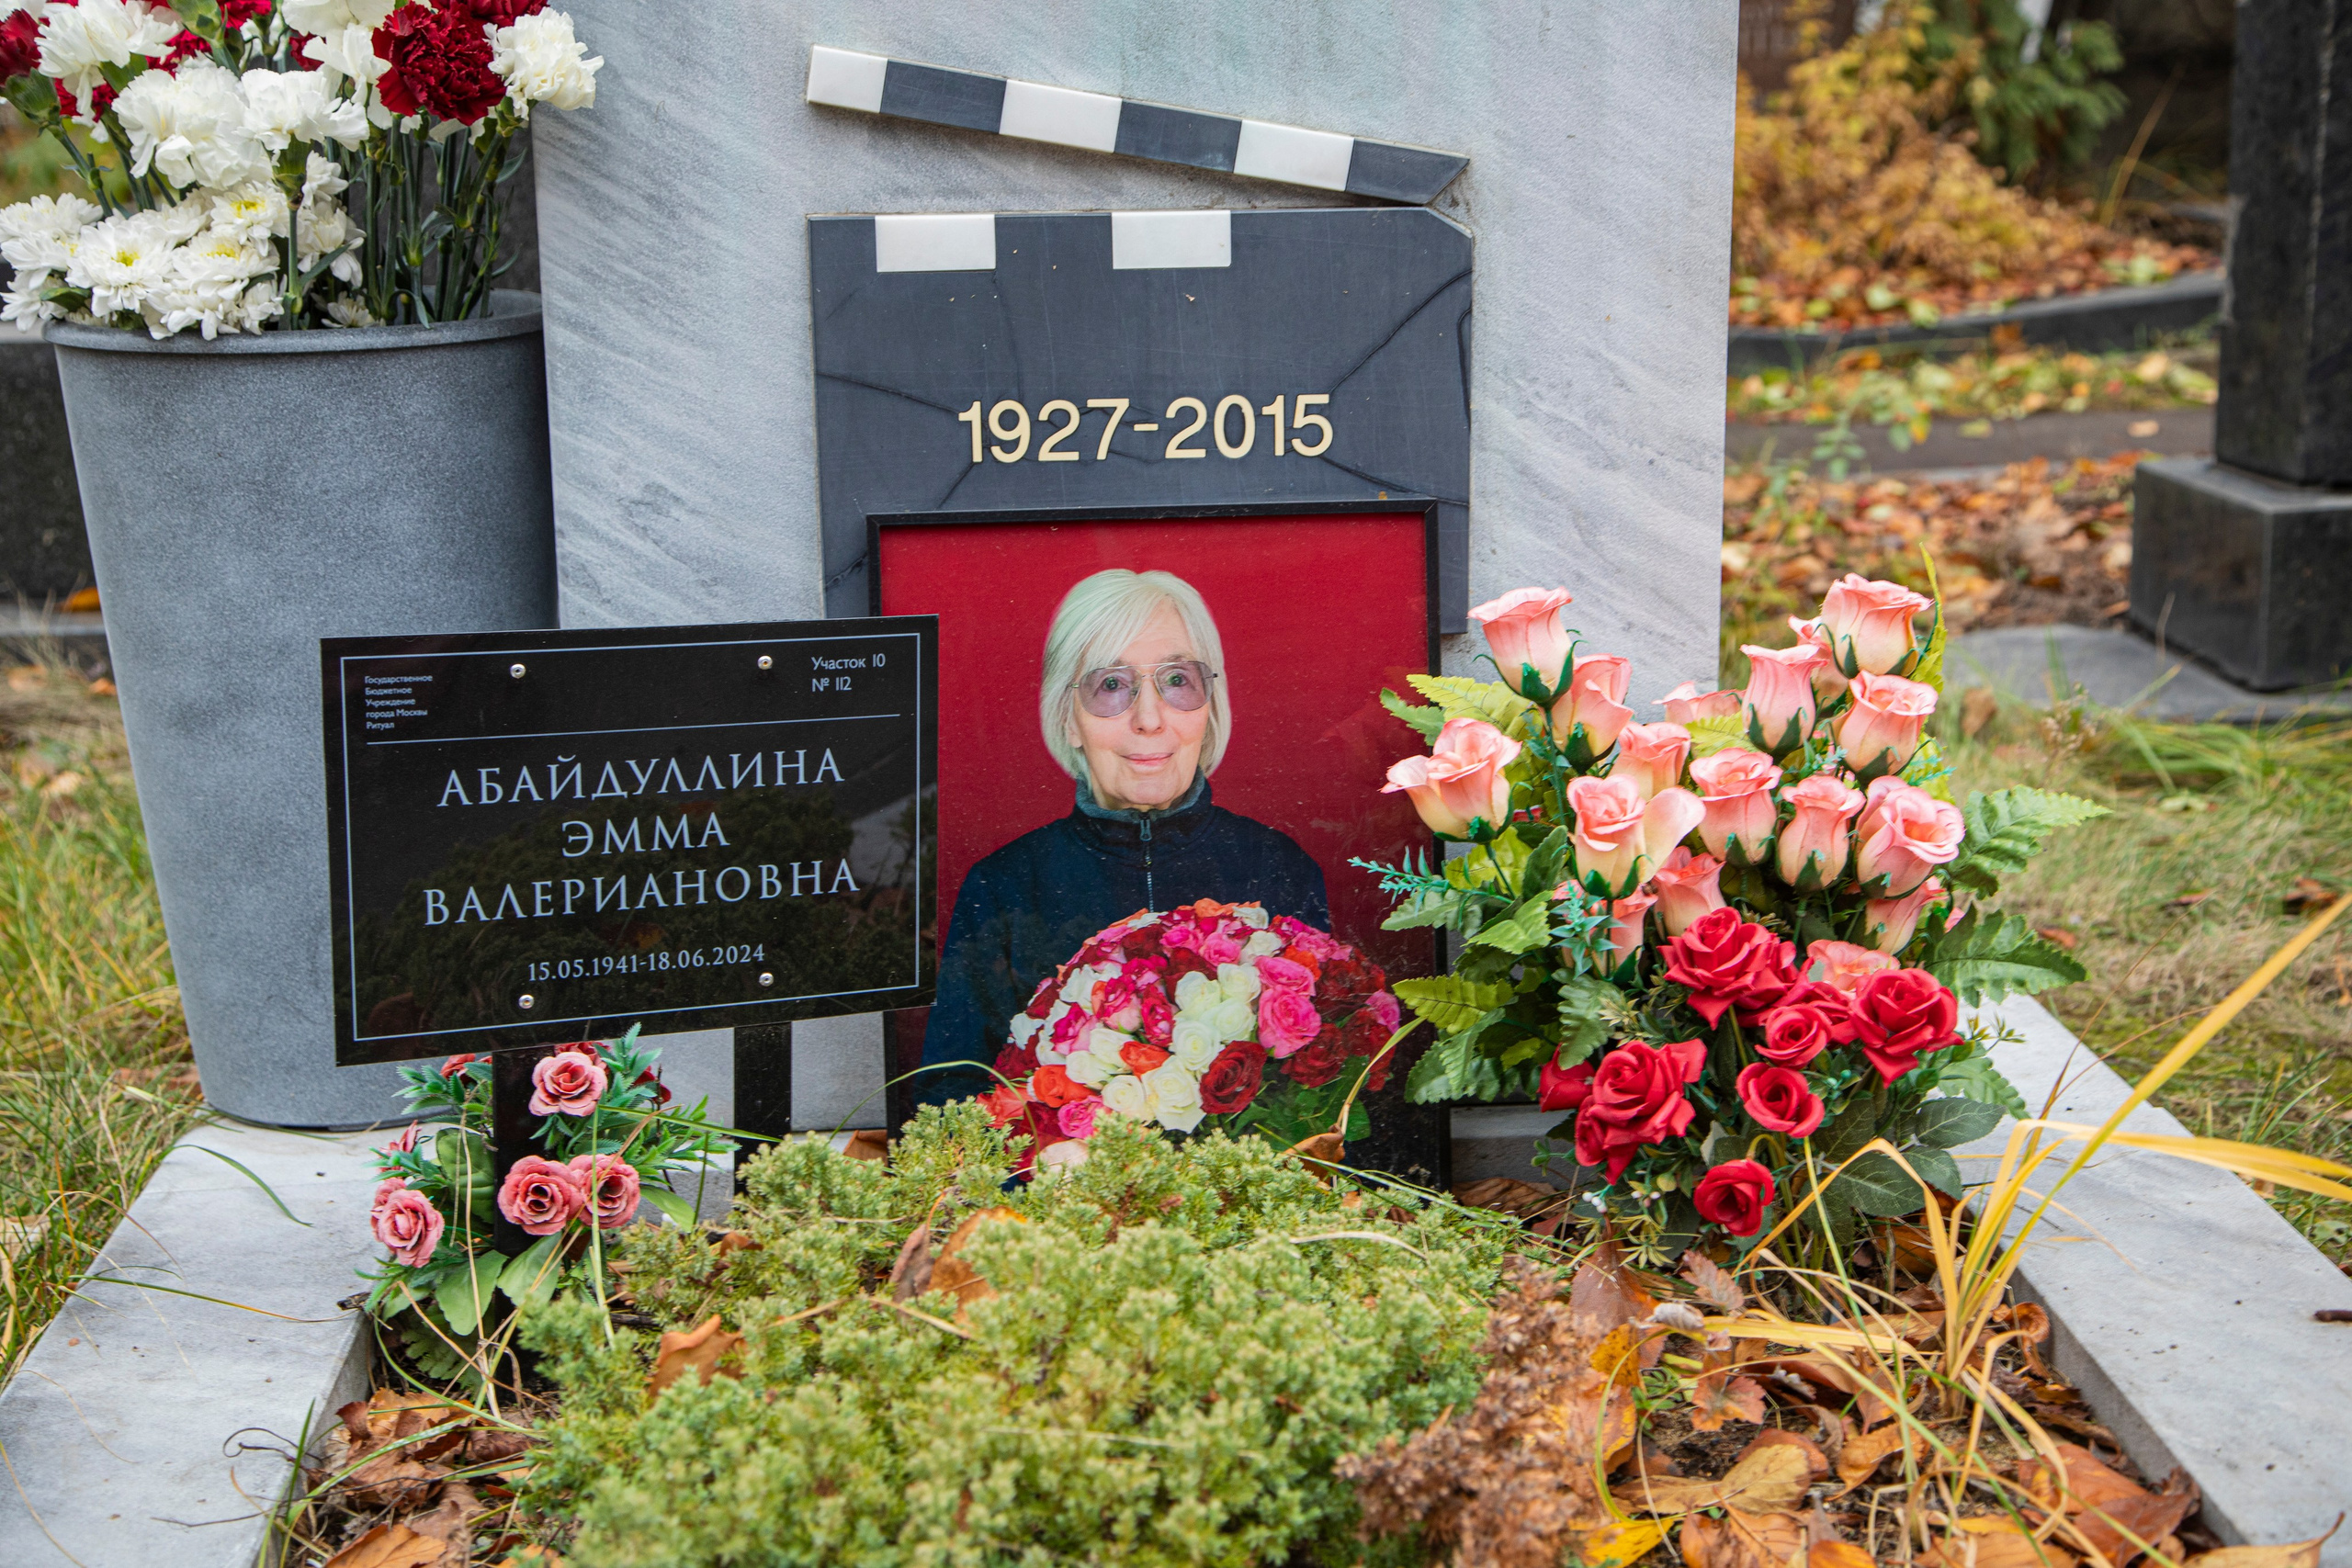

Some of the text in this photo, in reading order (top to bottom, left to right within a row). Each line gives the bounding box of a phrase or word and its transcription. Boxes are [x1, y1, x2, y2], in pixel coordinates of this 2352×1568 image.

[958, 393, 1333, 463] 1927-2015
[810, 653, 886, 671] Участок 10
[365, 675, 433, 684] Государственное
[811, 676, 852, 693] № 112
[365, 687, 413, 695] Бюджетное
[365, 699, 416, 708] Учреждение
[366, 711, 395, 719] города
[367, 722, 395, 730] Ритуал
[436, 748, 844, 807] АБАЙДУЛЛИНА
[561, 811, 730, 858] ЭММА
[423, 858, 860, 926] ВАЛЕРИАНОВНА
[527, 943, 765, 982] 15.05.1941-18.06.2024
